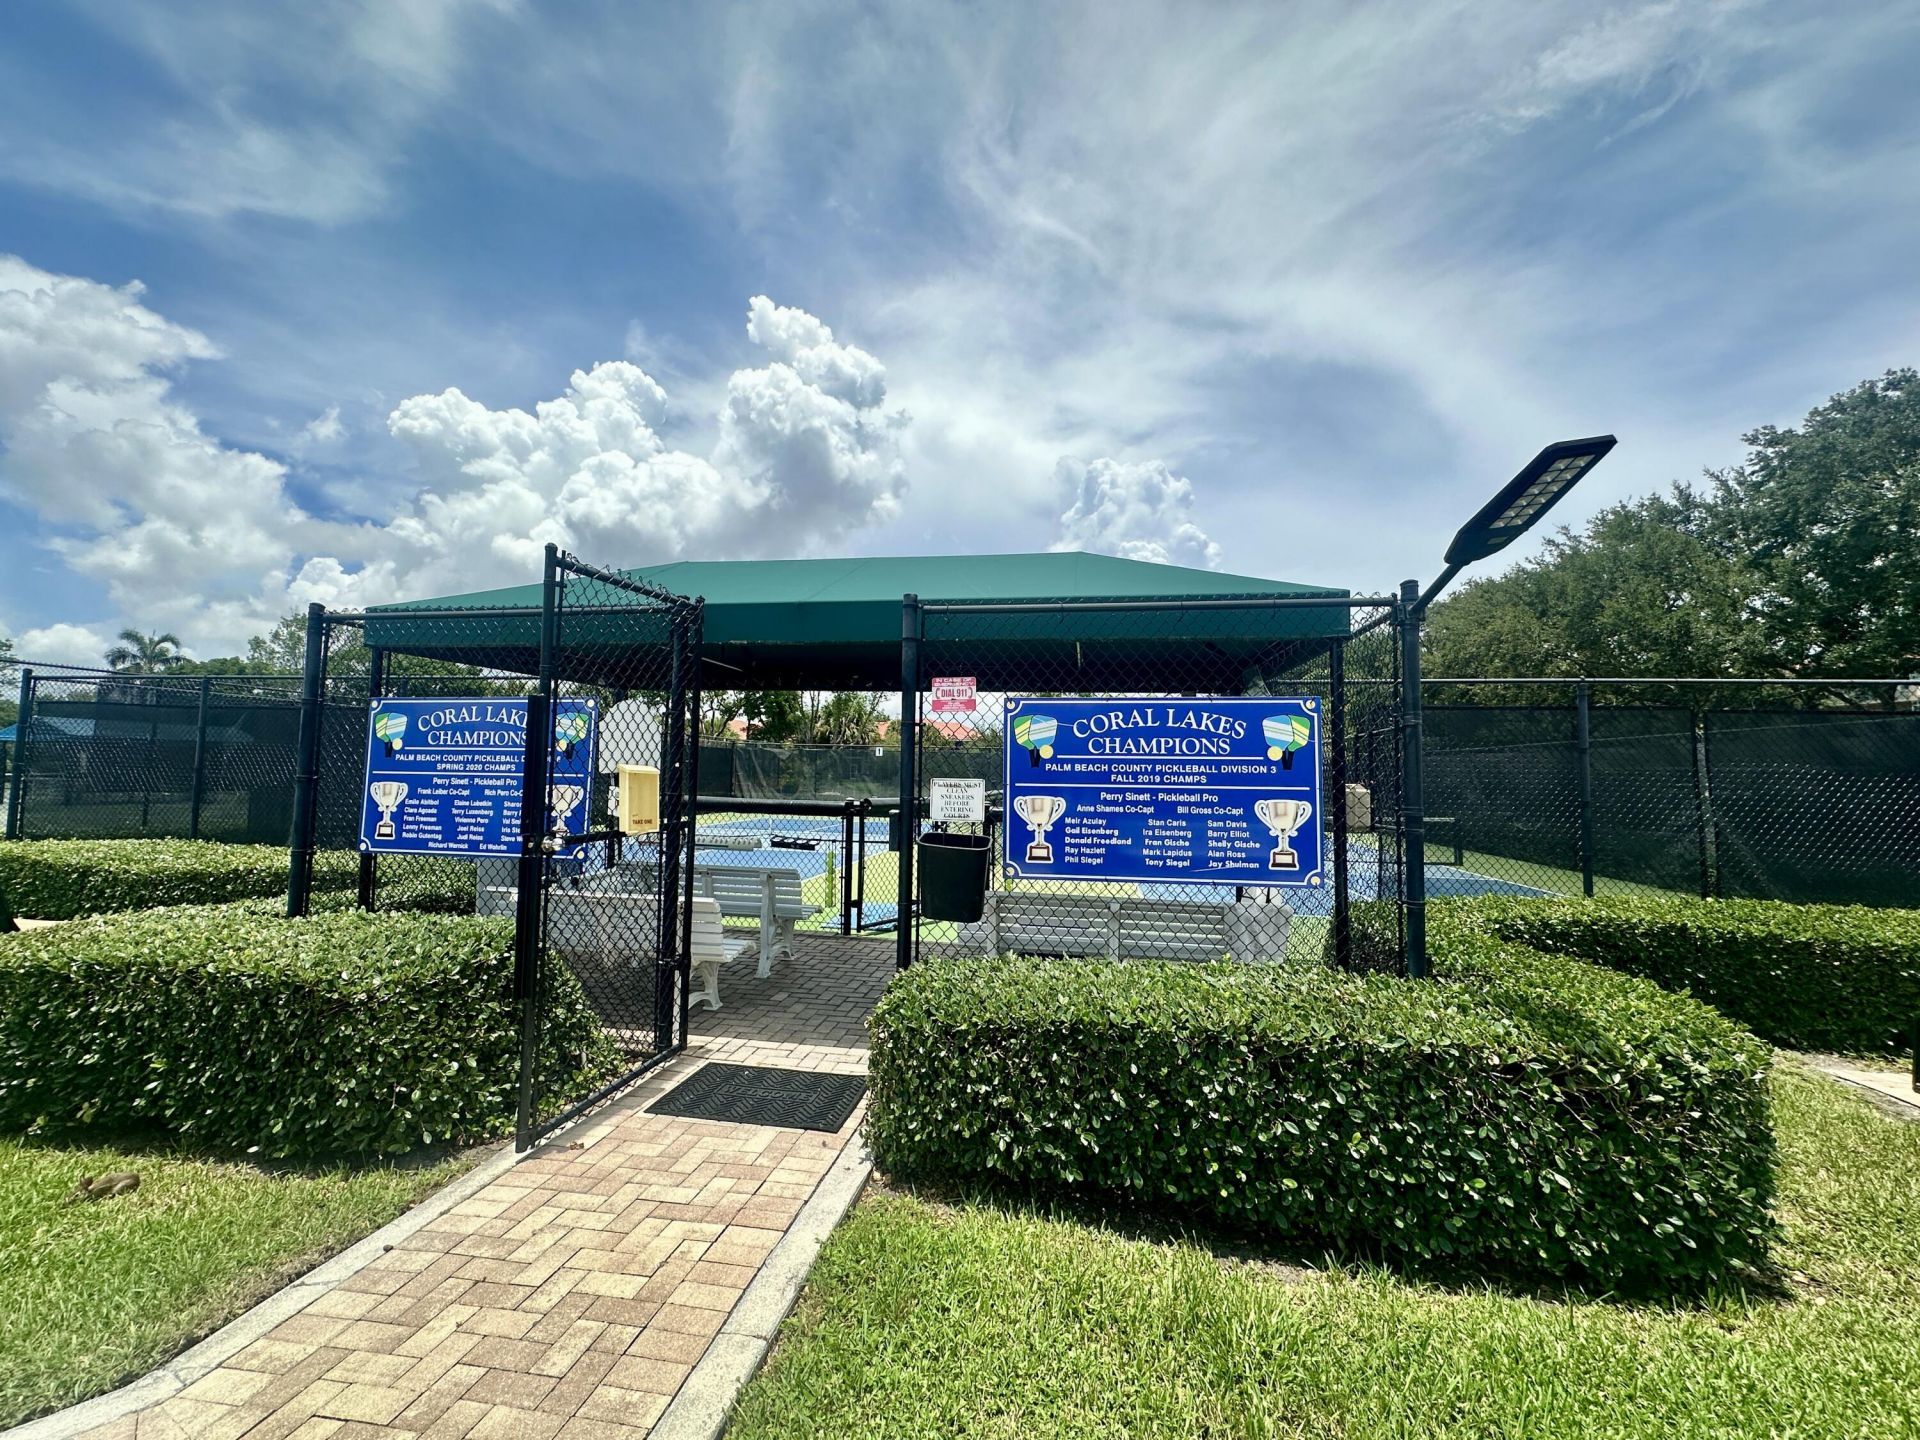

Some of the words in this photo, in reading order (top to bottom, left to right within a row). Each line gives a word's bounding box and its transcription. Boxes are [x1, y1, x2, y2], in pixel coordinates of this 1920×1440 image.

[941, 689, 955, 697] DIAL
[957, 689, 967, 697] 911
[418, 706, 481, 731] CORAL
[1073, 708, 1160, 738] CORAL
[1167, 708, 1247, 739] LAKES
[1088, 737, 1230, 754] CHAMPIONS
[1075, 764, 1108, 772] BEACH
[1111, 764, 1152, 772] COUNTY
[1156, 765, 1218, 773] PICKLEBALL
[1221, 765, 1267, 773] DIVISION
[1271, 766, 1276, 774] 3
[433, 777, 449, 786] Perry
[474, 778, 504, 786] Pickleball
[1138, 775, 1160, 783] 2019
[449, 788, 470, 796] Co-Capt
[1100, 792, 1123, 802] Perry
[1125, 792, 1150, 801] Sinett
[1158, 793, 1200, 802] Pickleball
[1203, 794, 1218, 802] Pro
[1077, 804, 1094, 812] Anne
[1096, 804, 1123, 812] Shames
[1125, 805, 1154, 814] Co-Capt
[1190, 806, 1212, 814] Gross
[1213, 807, 1243, 816] Co-Capt
[1082, 818, 1106, 826] Azulay
[1082, 827, 1118, 836] Eisenberg
[1155, 829, 1192, 838] Eisenberg
[1208, 830, 1228, 838] Barry
[1230, 830, 1249, 838] Elliot
[1093, 837, 1131, 845] Freedland
[1208, 840, 1232, 848] Shelly
[1065, 846, 1078, 854] Ray
[1163, 849, 1192, 857] Lapidus
[1081, 856, 1103, 865] Siegel
[1145, 858, 1163, 867] Tony
[1166, 859, 1190, 867] Siegel
[1208, 860, 1223, 869] Jay
[723, 1085, 814, 1102] WELCOME
